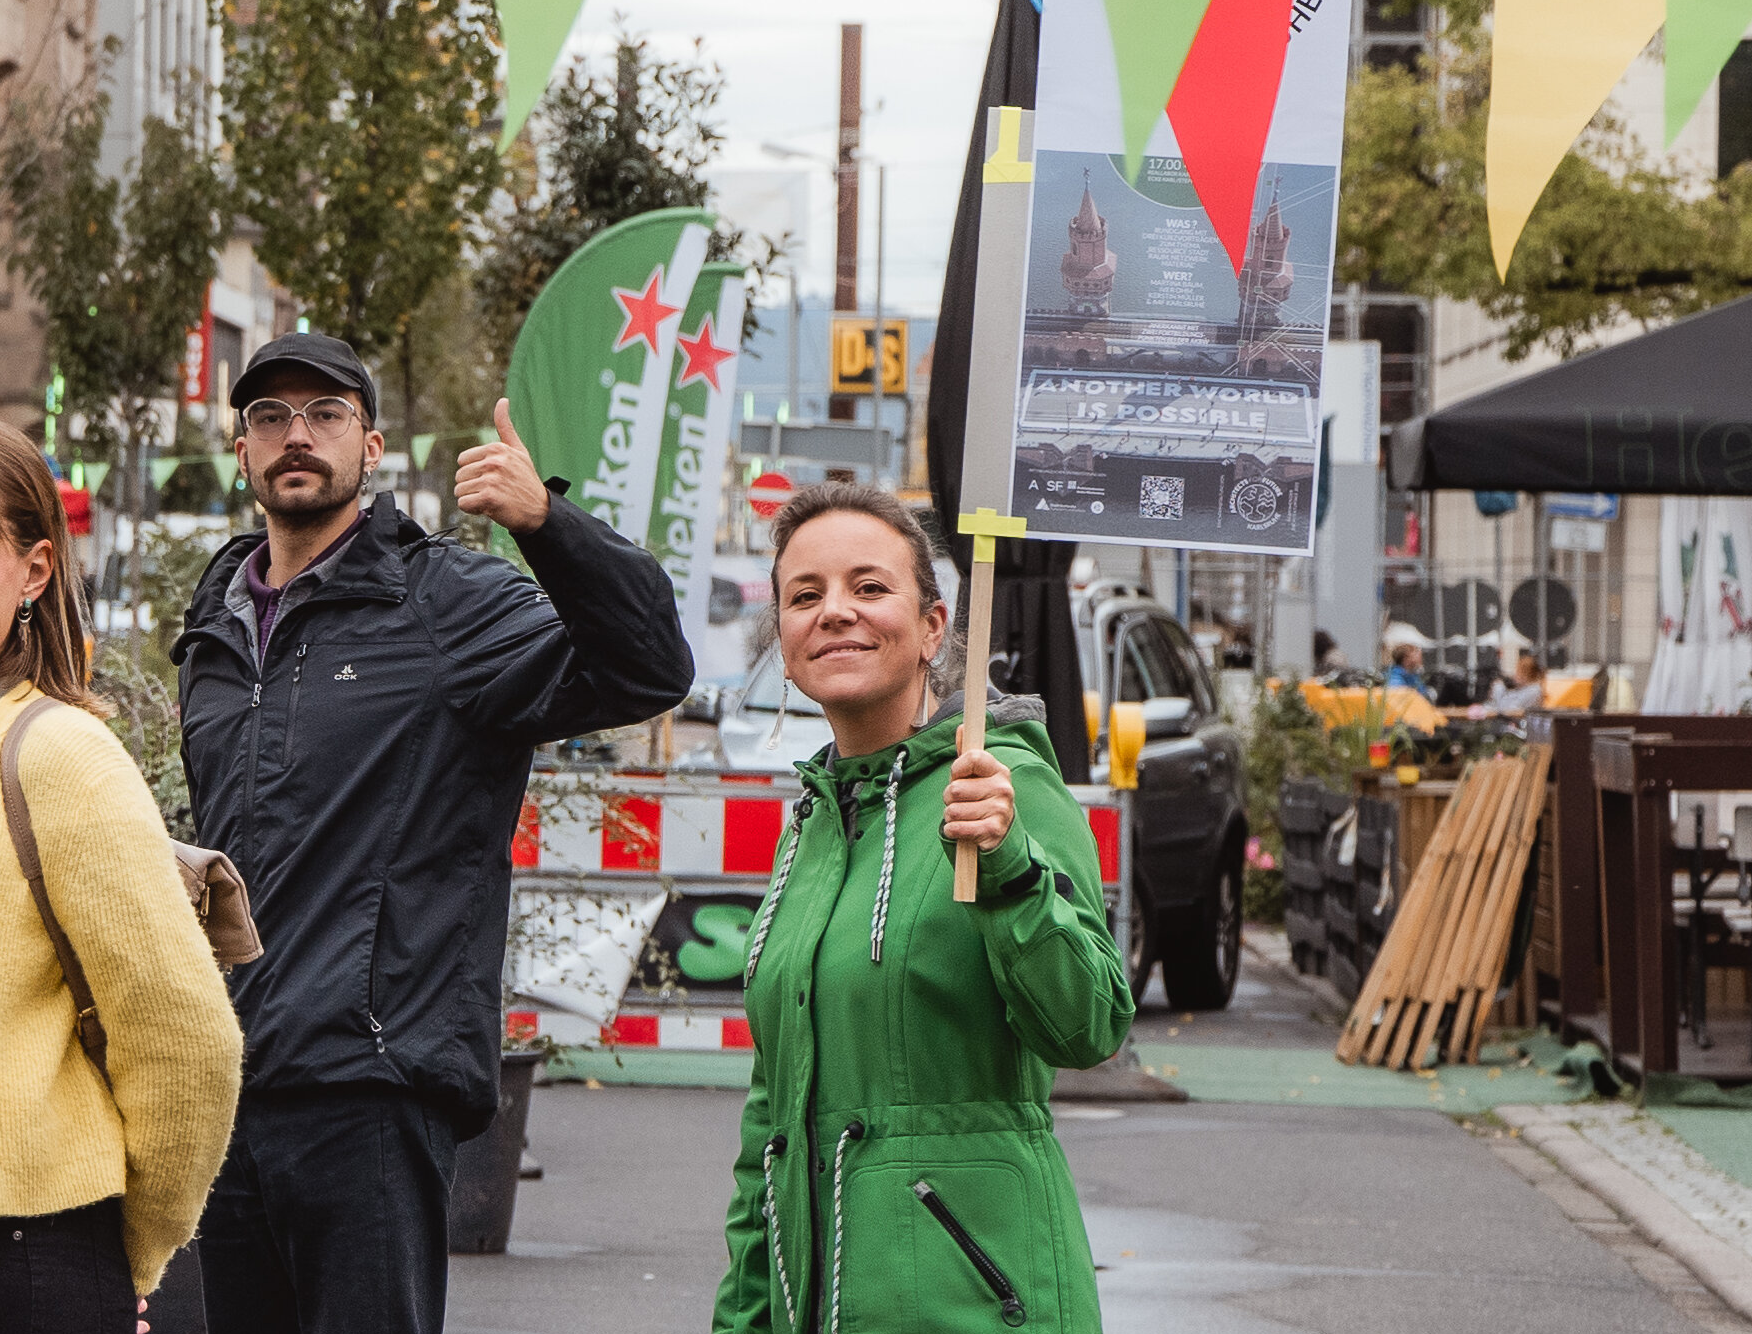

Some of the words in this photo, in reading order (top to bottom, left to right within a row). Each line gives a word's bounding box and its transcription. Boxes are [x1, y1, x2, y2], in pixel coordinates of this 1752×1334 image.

[1148, 157, 1182, 171] 17.00
[840, 329, 902, 387] DS
[1035, 378, 1183, 398] ANOTHER
[1188, 383, 1299, 405] WORLD
[1077, 401, 1107, 420] IS
[1117, 403, 1268, 428] POSSIBLE
